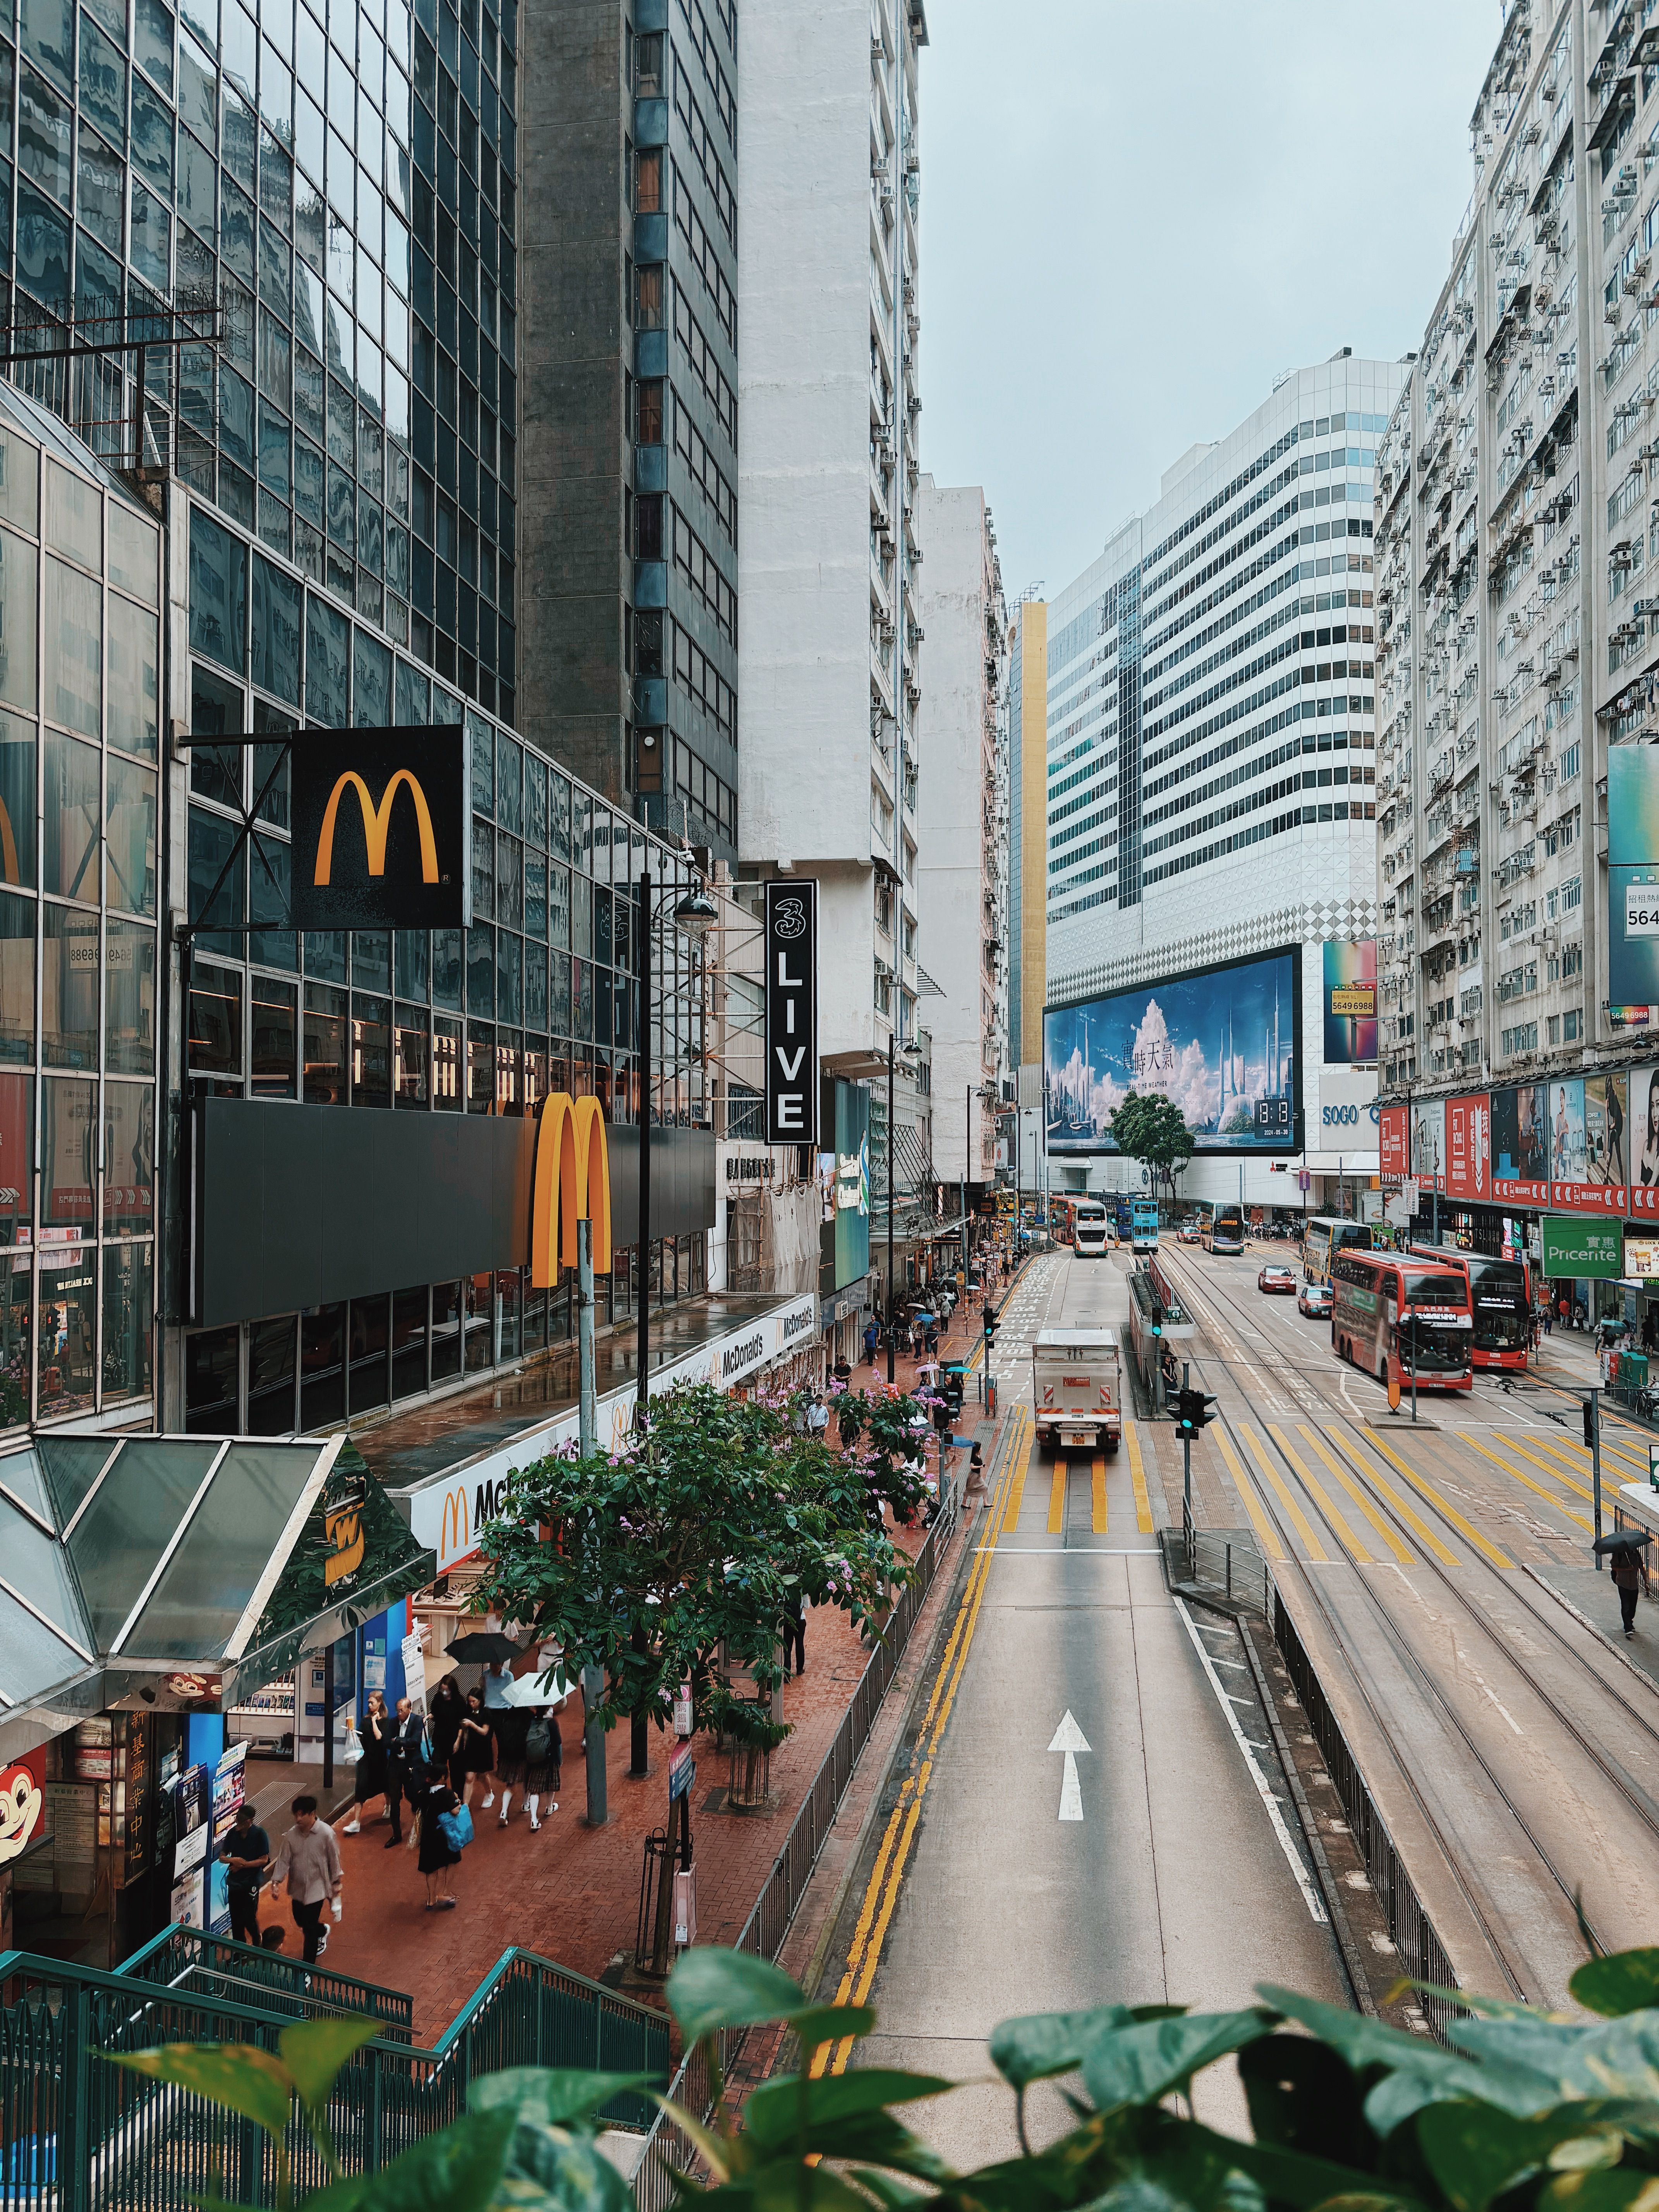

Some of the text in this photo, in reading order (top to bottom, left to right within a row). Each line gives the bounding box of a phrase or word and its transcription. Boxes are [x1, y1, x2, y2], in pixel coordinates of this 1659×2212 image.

[775, 898, 806, 1128] 3 LIVE
[1121, 1040, 1173, 1076] 實時天氣
[1323, 1104, 1358, 1125] SOGO
[1549, 1246, 1616, 1261] Pricerite
[1587, 1235, 1616, 1249] 實惠
[784, 1306, 812, 1340] McDonald's
[723, 1333, 763, 1378] McDonald's
[677, 1702, 687, 1733] 銅鑼灣
